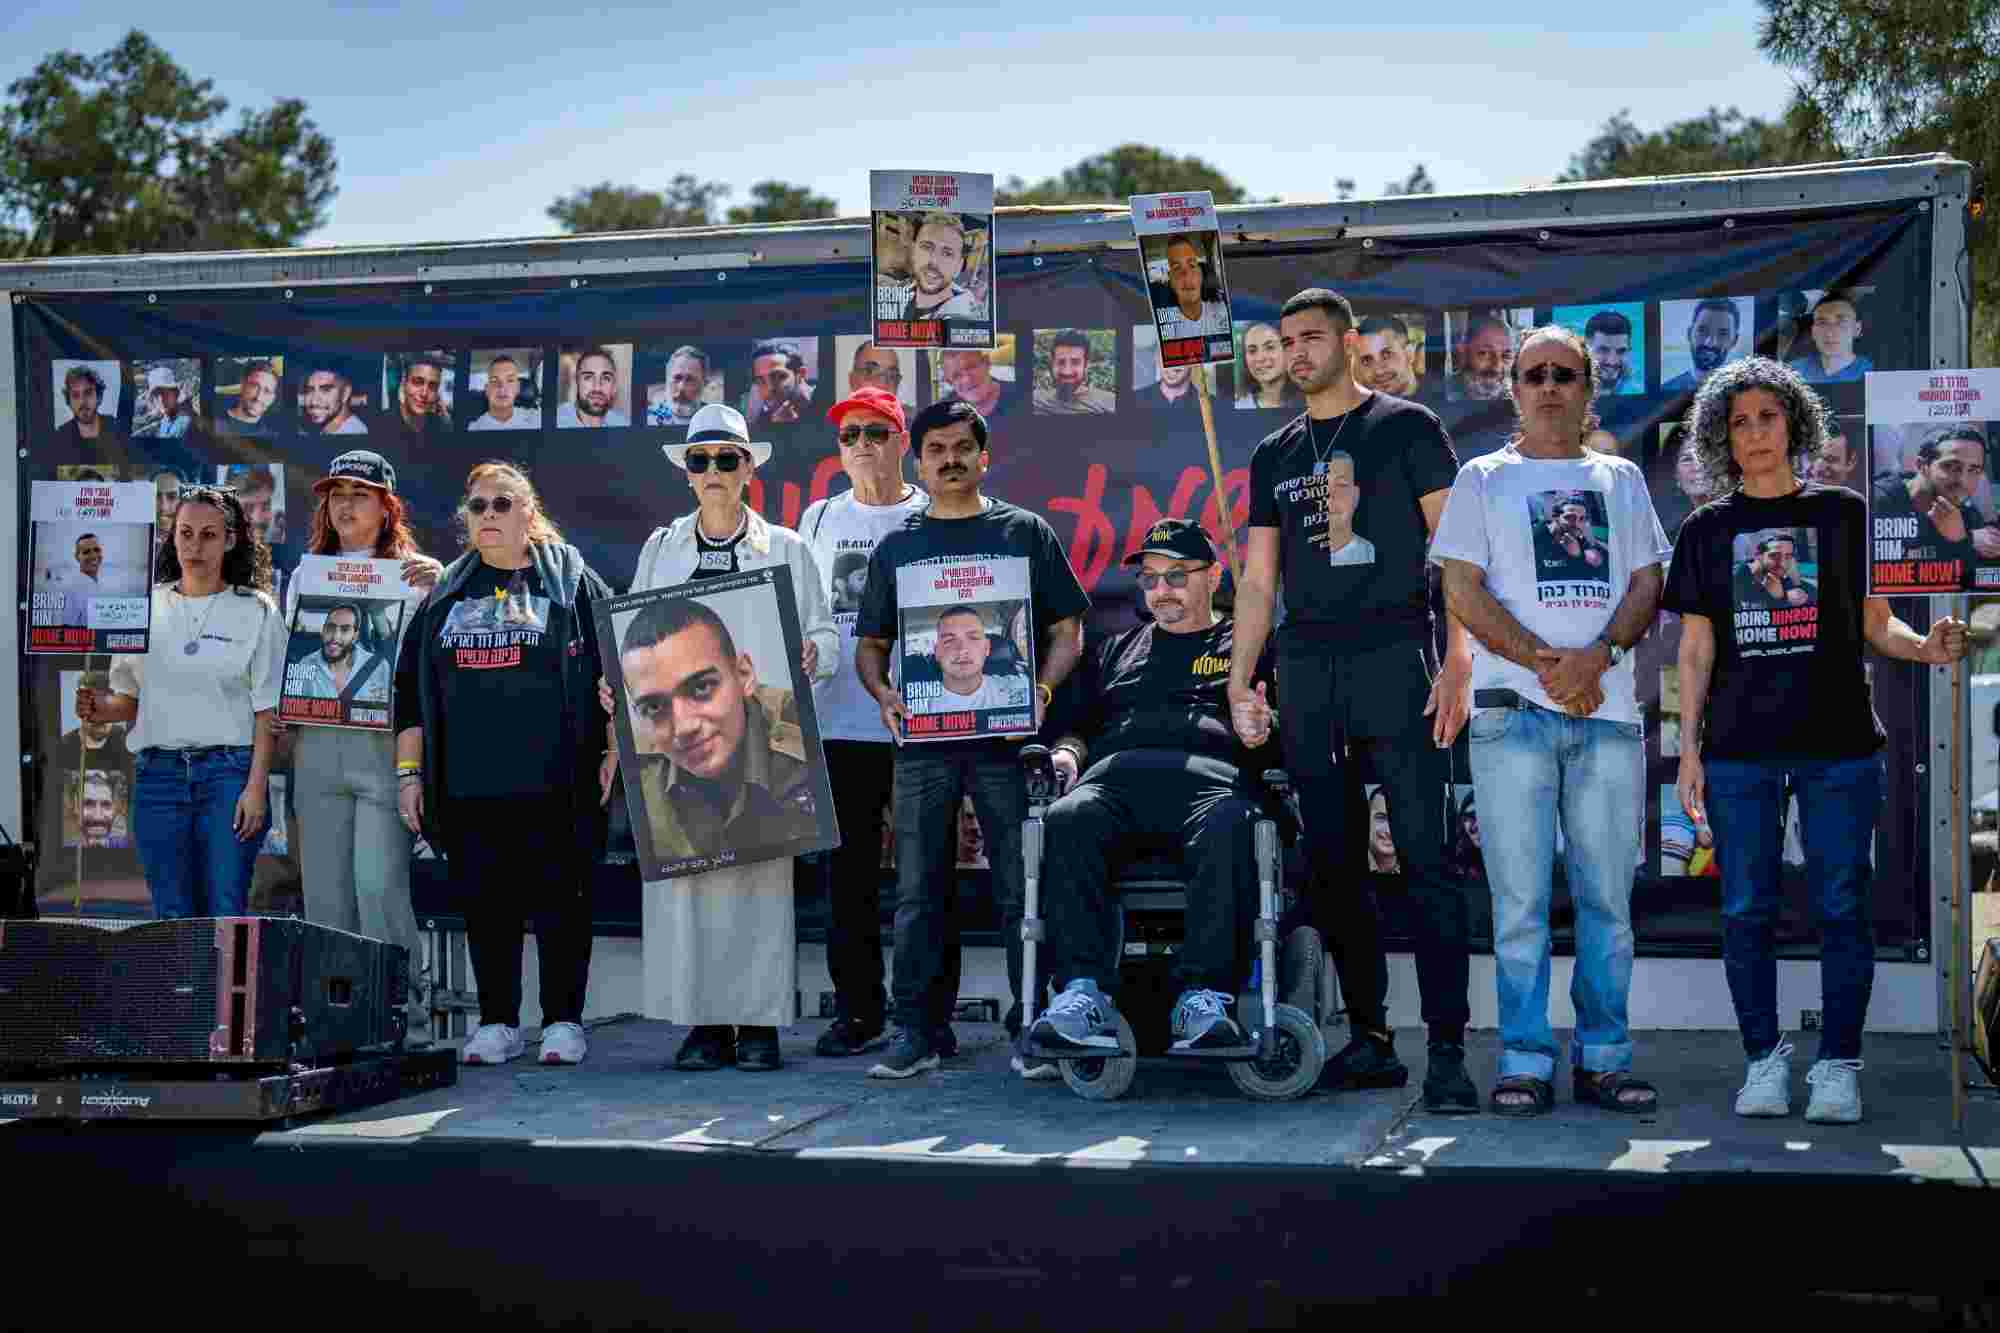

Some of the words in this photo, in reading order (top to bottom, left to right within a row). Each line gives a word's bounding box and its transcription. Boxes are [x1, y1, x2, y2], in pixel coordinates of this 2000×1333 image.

[1873, 517, 1919, 539] BRING
[1874, 539, 1903, 561] HIM
[1872, 561, 1916, 585] HOME
[1919, 560, 1961, 584] NOW!
[1537, 584, 1566, 601] כהן
[1733, 610, 1770, 628] BRING
[1735, 626, 1777, 645] HOME
[1779, 622, 1817, 641] NOW!
[906, 680, 942, 699] BRING
